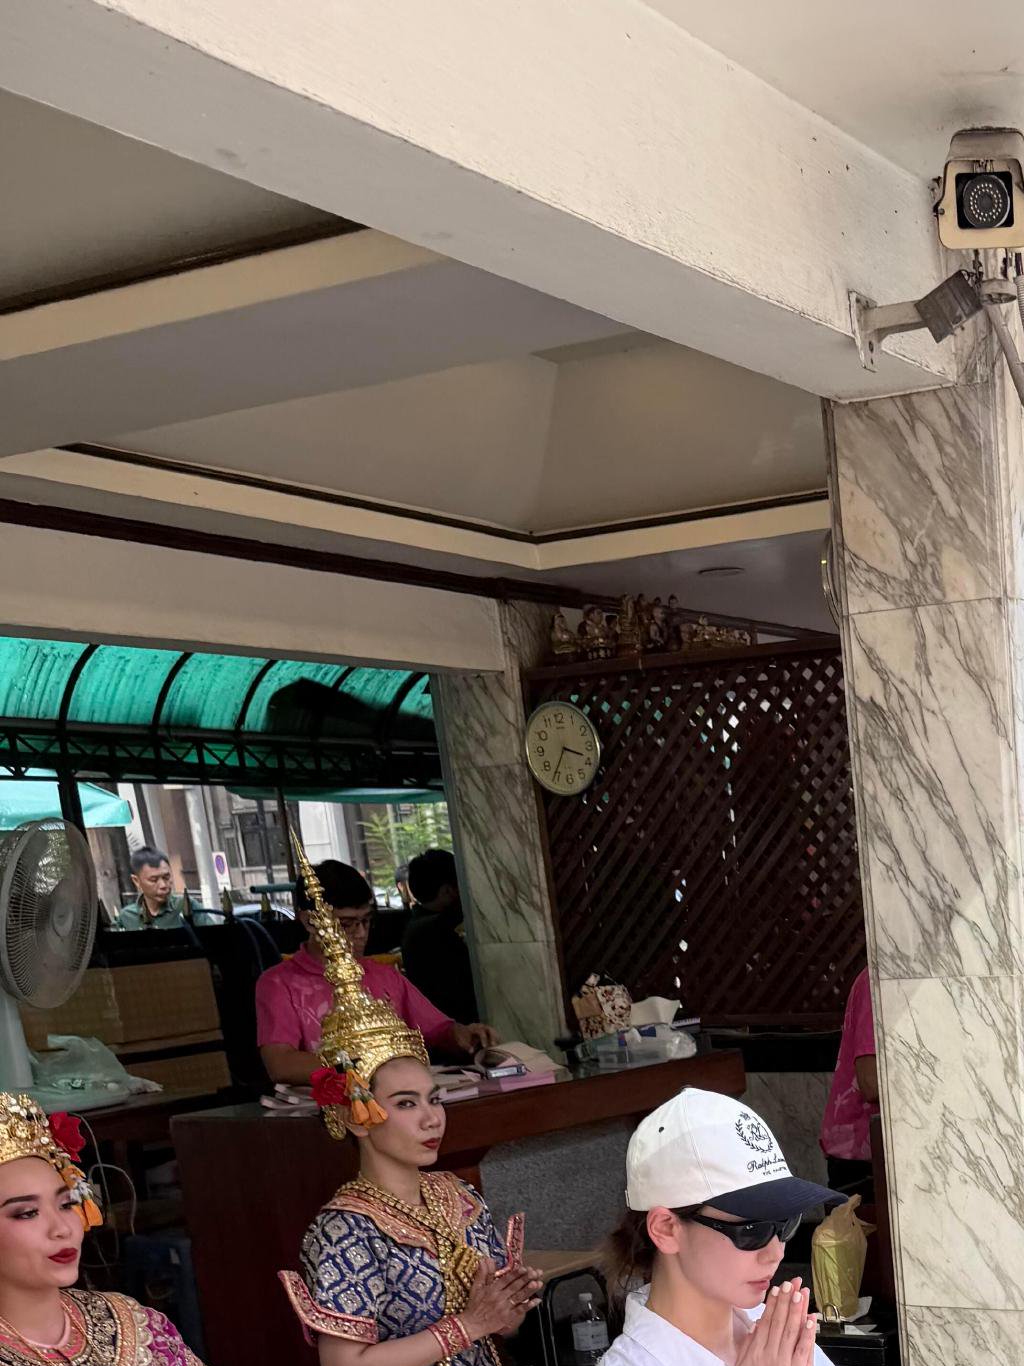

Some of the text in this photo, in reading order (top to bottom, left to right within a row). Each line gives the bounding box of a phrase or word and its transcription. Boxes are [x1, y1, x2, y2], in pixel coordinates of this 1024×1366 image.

[544, 718, 552, 728] 11
[554, 712, 565, 723] 12
[570, 712, 575, 725] 1
[579, 725, 587, 736] 2
[536, 746, 544, 757] 9
[585, 741, 593, 751] 3
[543, 760, 551, 771] 8
[584, 757, 591, 767] 4
[566, 773, 574, 784] 6
[577, 768, 586, 780] 5
[747, 1157, 772, 1173] Ralph
